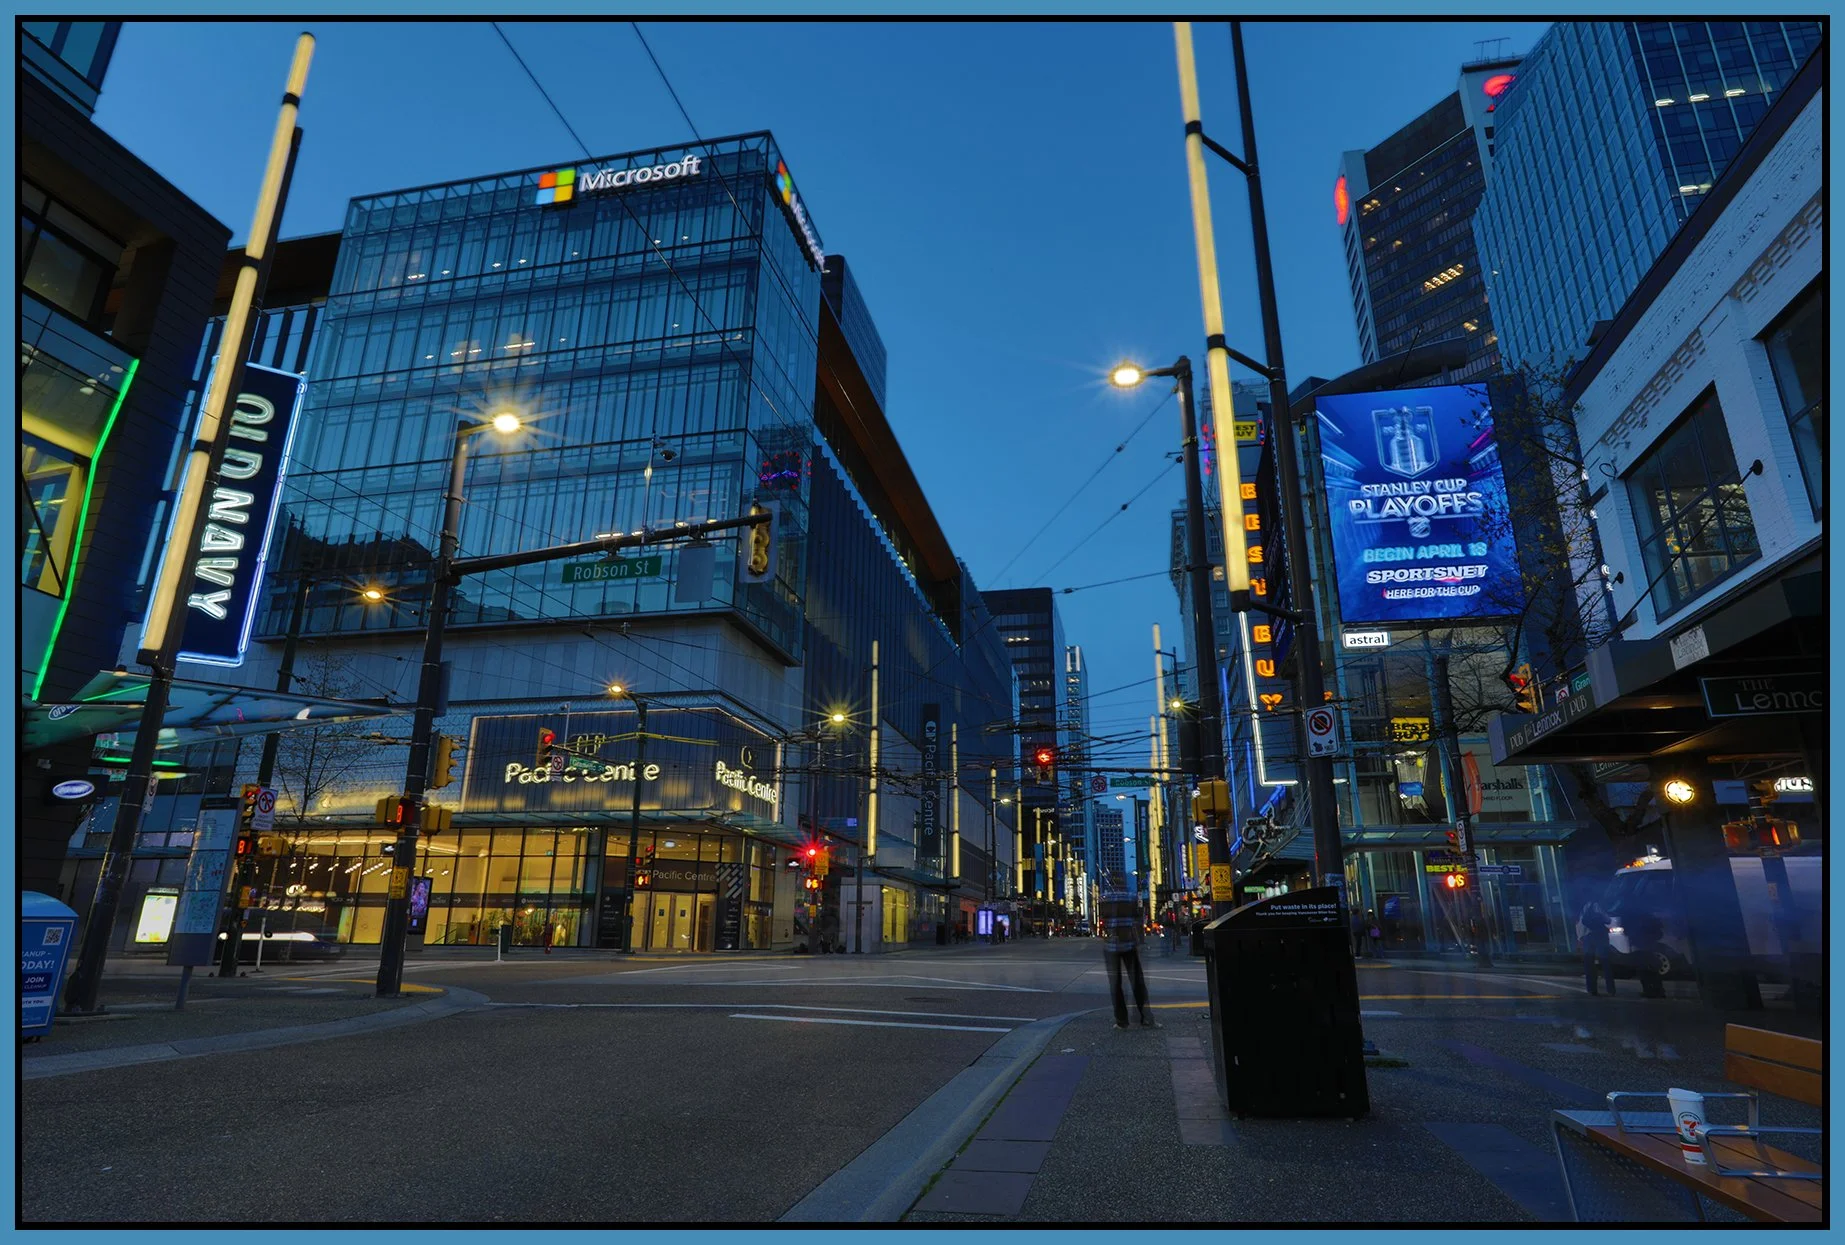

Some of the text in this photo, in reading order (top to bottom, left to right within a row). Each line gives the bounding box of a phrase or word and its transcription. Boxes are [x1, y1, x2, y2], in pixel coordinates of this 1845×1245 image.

[578, 154, 702, 193] Microsoft
[1361, 477, 1468, 498] STANLEY CUP
[1350, 491, 1484, 519] PLAYOFFS
[187, 486, 254, 621] NAVY
[1363, 546, 1414, 563] BEGIN
[1416, 543, 1466, 560] APRIL
[573, 560, 650, 580] Robson St
[1366, 564, 1489, 584] SPORTSNET
[1240, 483, 1282, 711] BEST BUY
[1385, 584, 1481, 600] HERE FOR THE CUP
[1349, 633, 1385, 646] astral
[1737, 678, 1774, 691] THE
[1569, 694, 1588, 716] PUB
[1532, 710, 1562, 737] Lennox
[1509, 731, 1524, 750] PUB
[715, 760, 777, 805] Pacific Centre
[652, 870, 716, 881] Pacific Centre
[25, 976, 45, 984] JOIN
